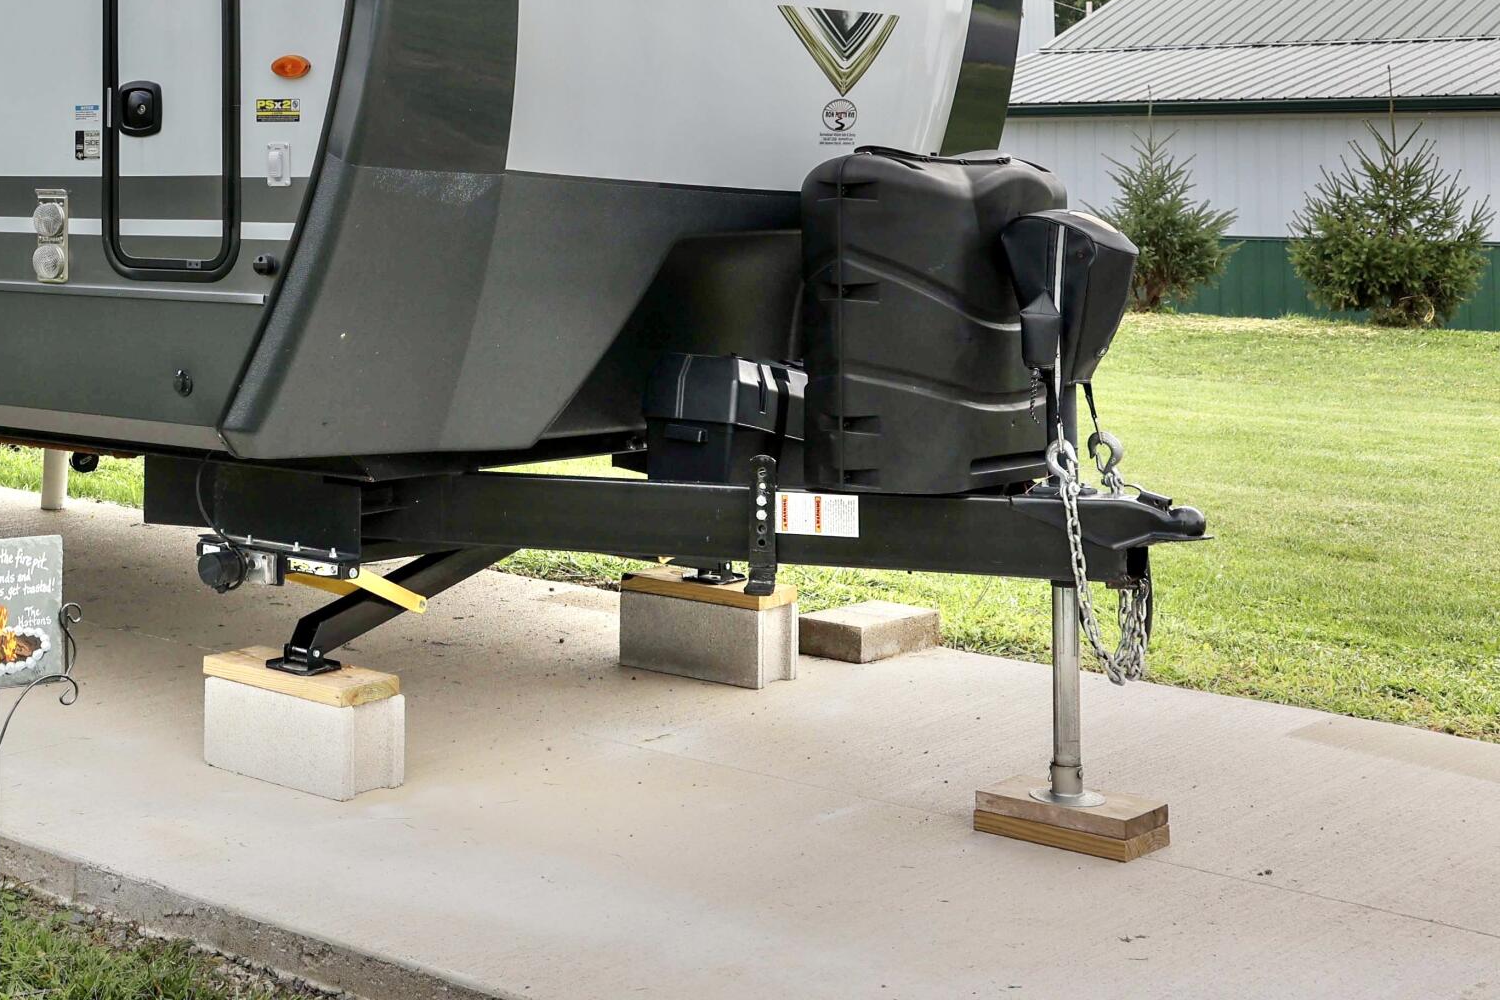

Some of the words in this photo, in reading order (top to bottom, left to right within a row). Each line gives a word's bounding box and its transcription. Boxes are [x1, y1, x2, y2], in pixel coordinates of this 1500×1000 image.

[257, 100, 291, 109] PSx2
[0, 548, 13, 564] the
[17, 568, 31, 582] and
[4, 583, 21, 600] get
[24, 605, 42, 617] The
